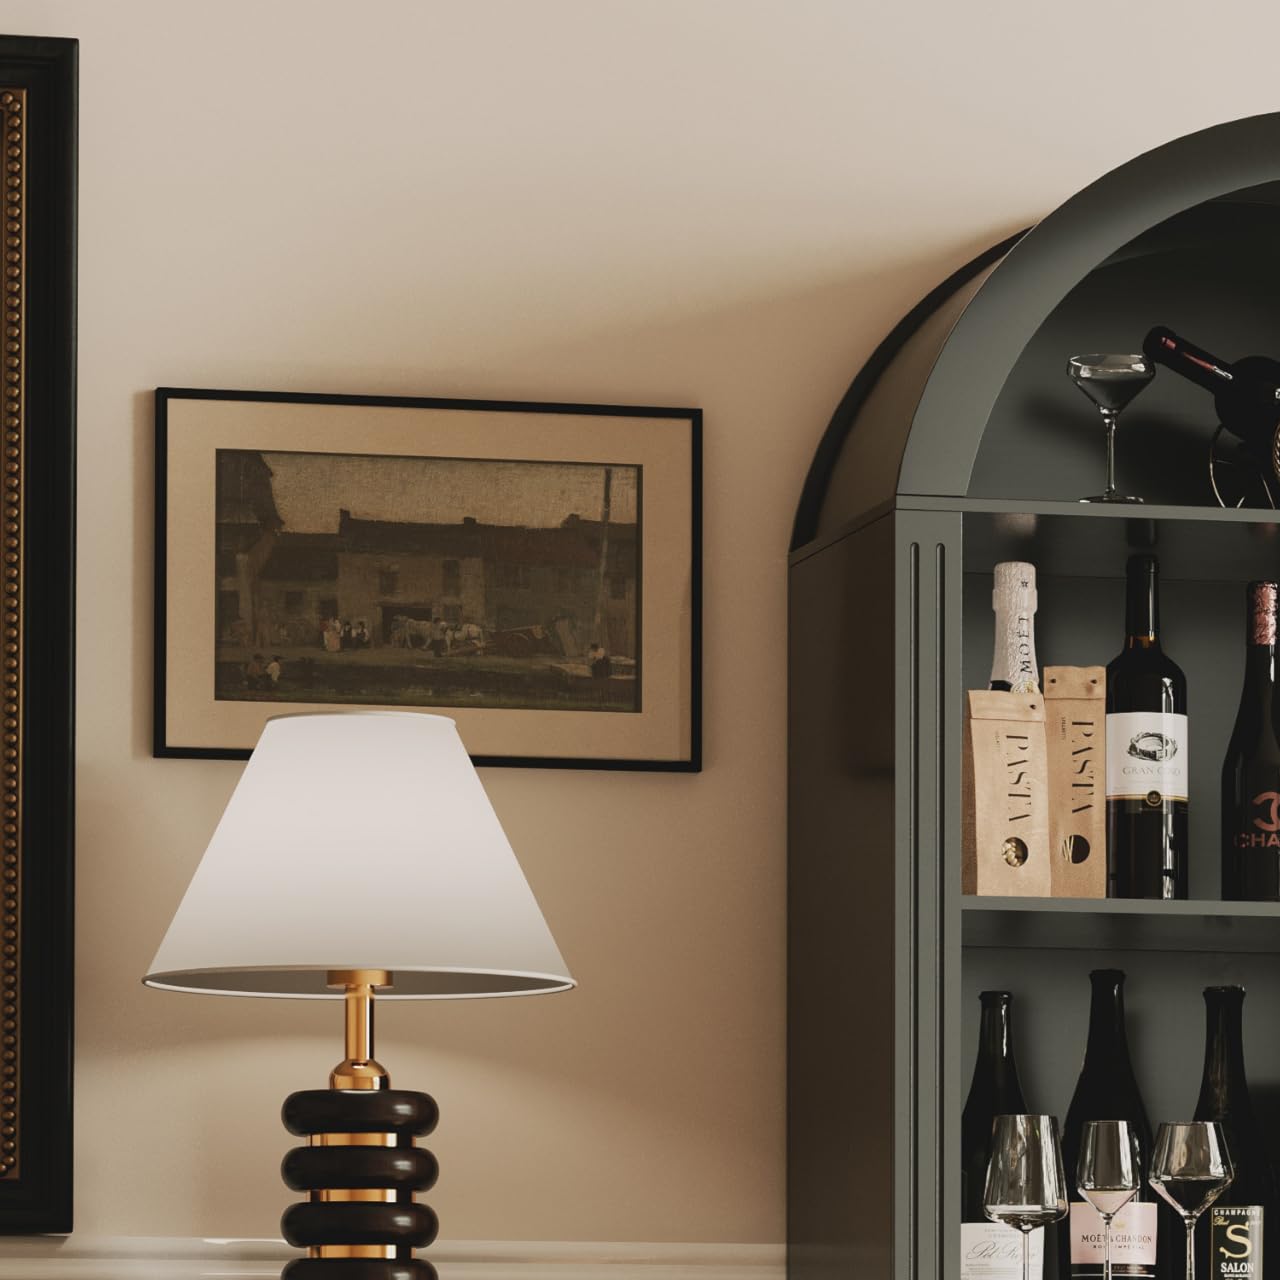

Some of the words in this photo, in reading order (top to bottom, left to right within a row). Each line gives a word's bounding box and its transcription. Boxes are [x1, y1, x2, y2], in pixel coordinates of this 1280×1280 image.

[1006, 734, 1032, 822] PASTA
[1071, 721, 1094, 814] PASTA
[1220, 1262, 1254, 1273] SALON
